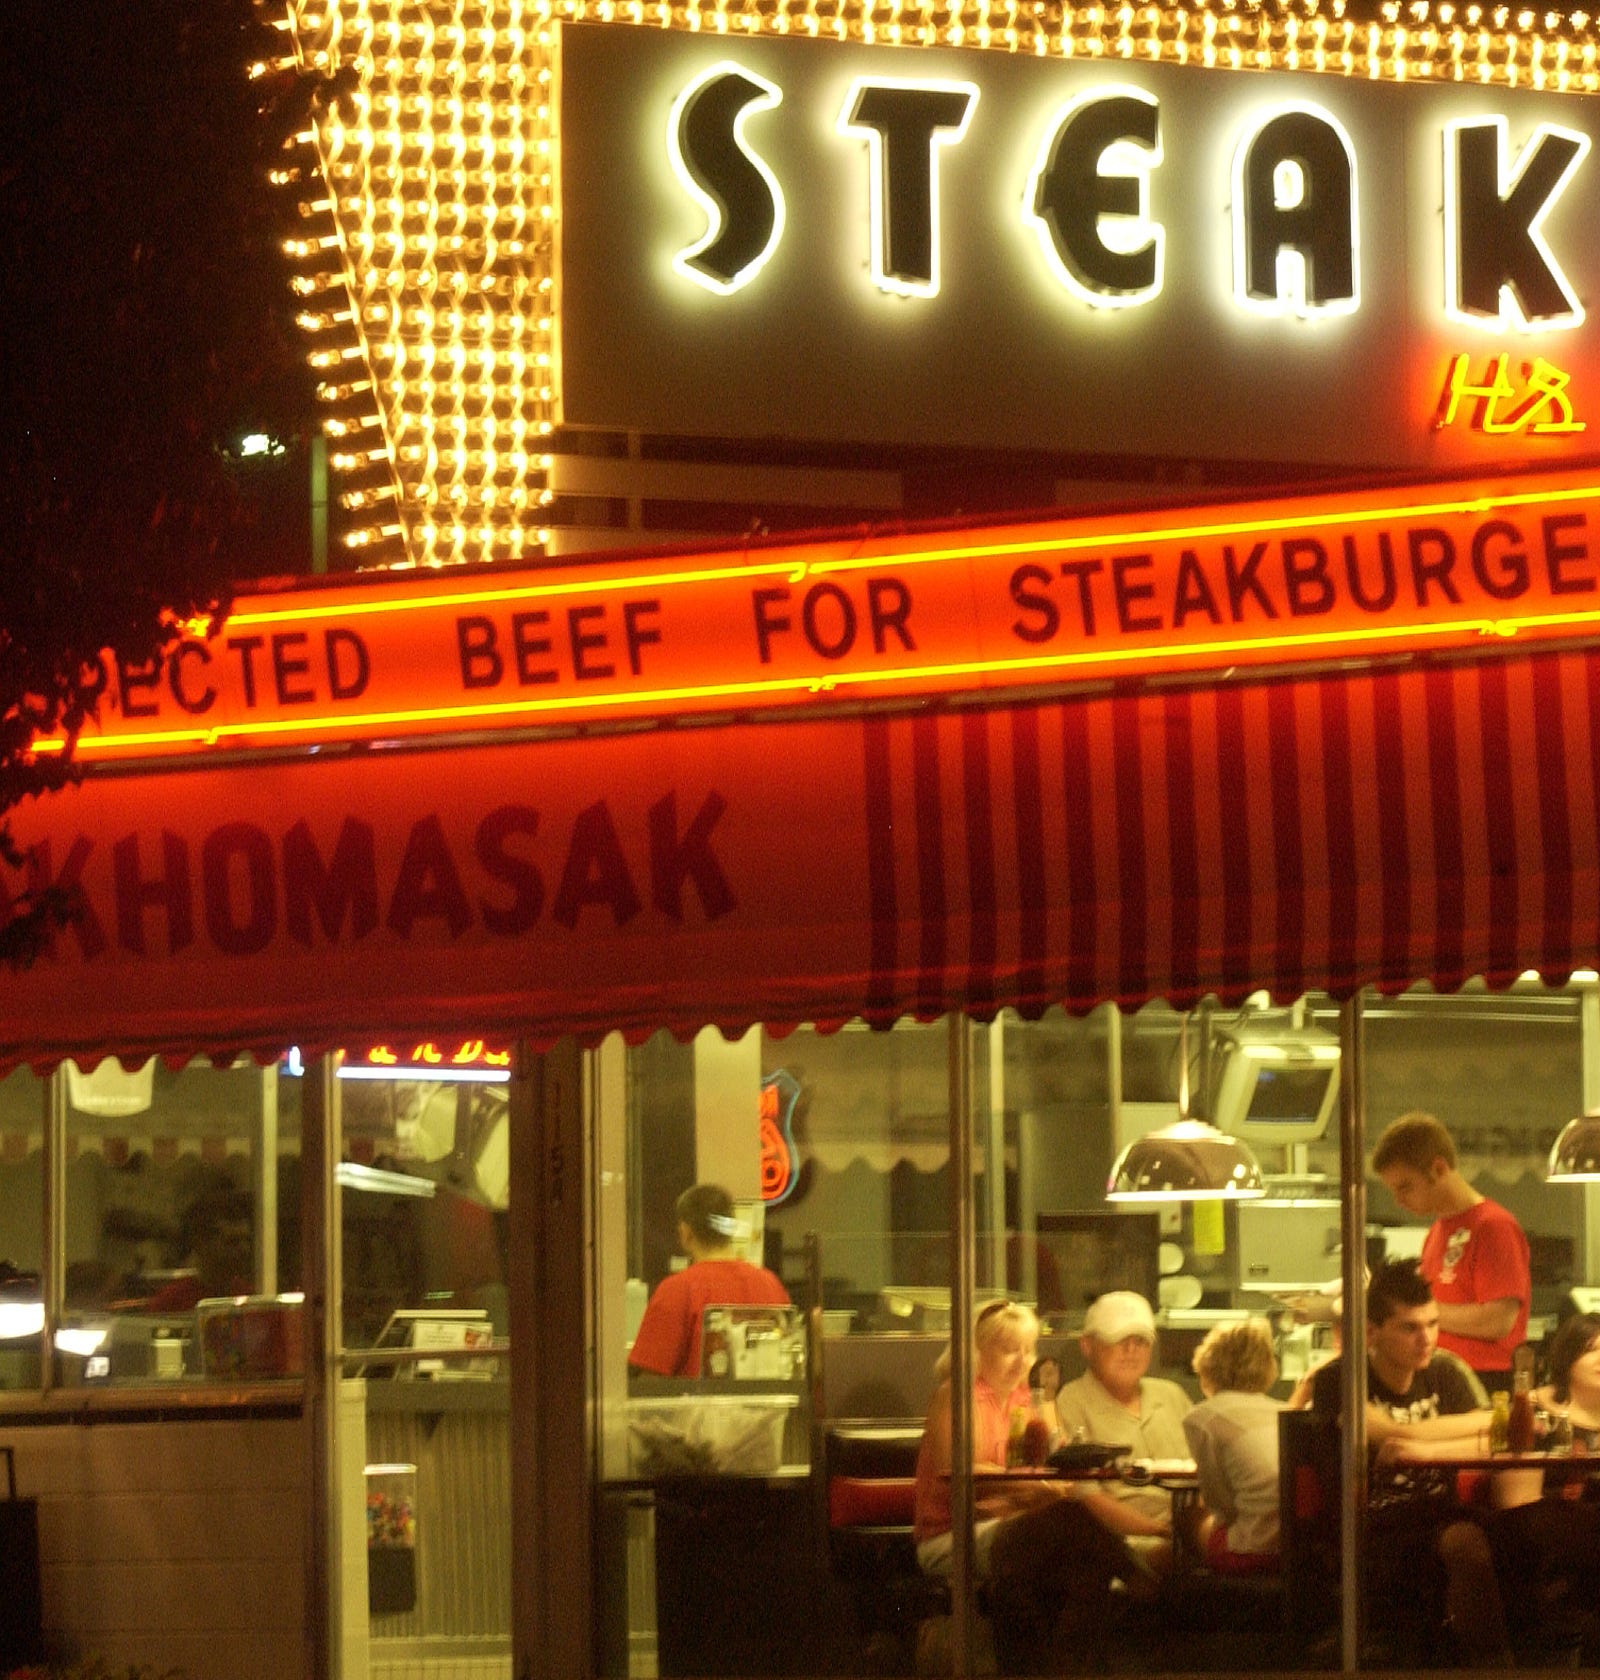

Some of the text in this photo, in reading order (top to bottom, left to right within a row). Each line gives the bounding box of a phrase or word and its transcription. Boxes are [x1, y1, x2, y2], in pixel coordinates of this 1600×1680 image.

[666, 60, 1592, 330] STEAK
[456, 600, 663, 690] BEEF
[752, 578, 917, 664] FOR
[0, 788, 737, 966] KHOMASAK
